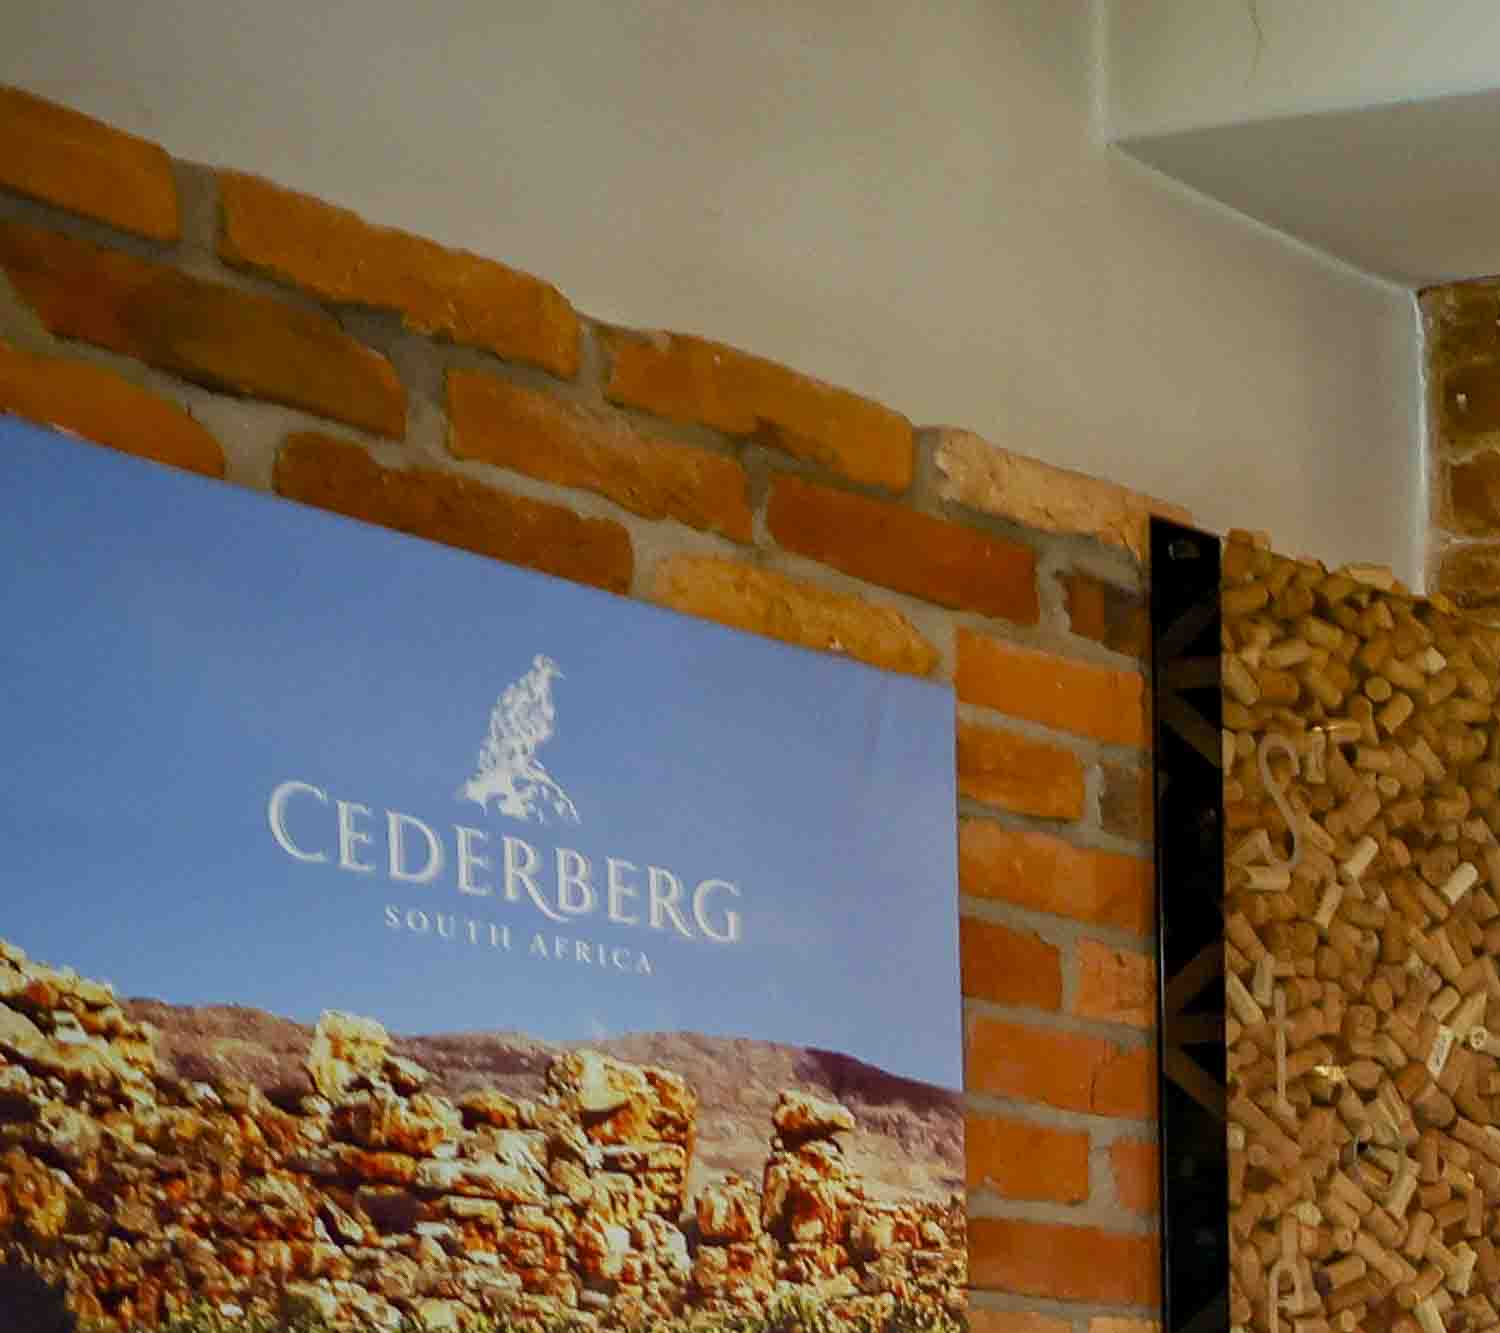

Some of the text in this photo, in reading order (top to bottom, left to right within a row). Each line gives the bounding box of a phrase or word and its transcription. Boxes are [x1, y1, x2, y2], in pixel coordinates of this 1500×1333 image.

[269, 780, 742, 943] CEDERBERG
[383, 903, 656, 977] SOUTH AFRICA
